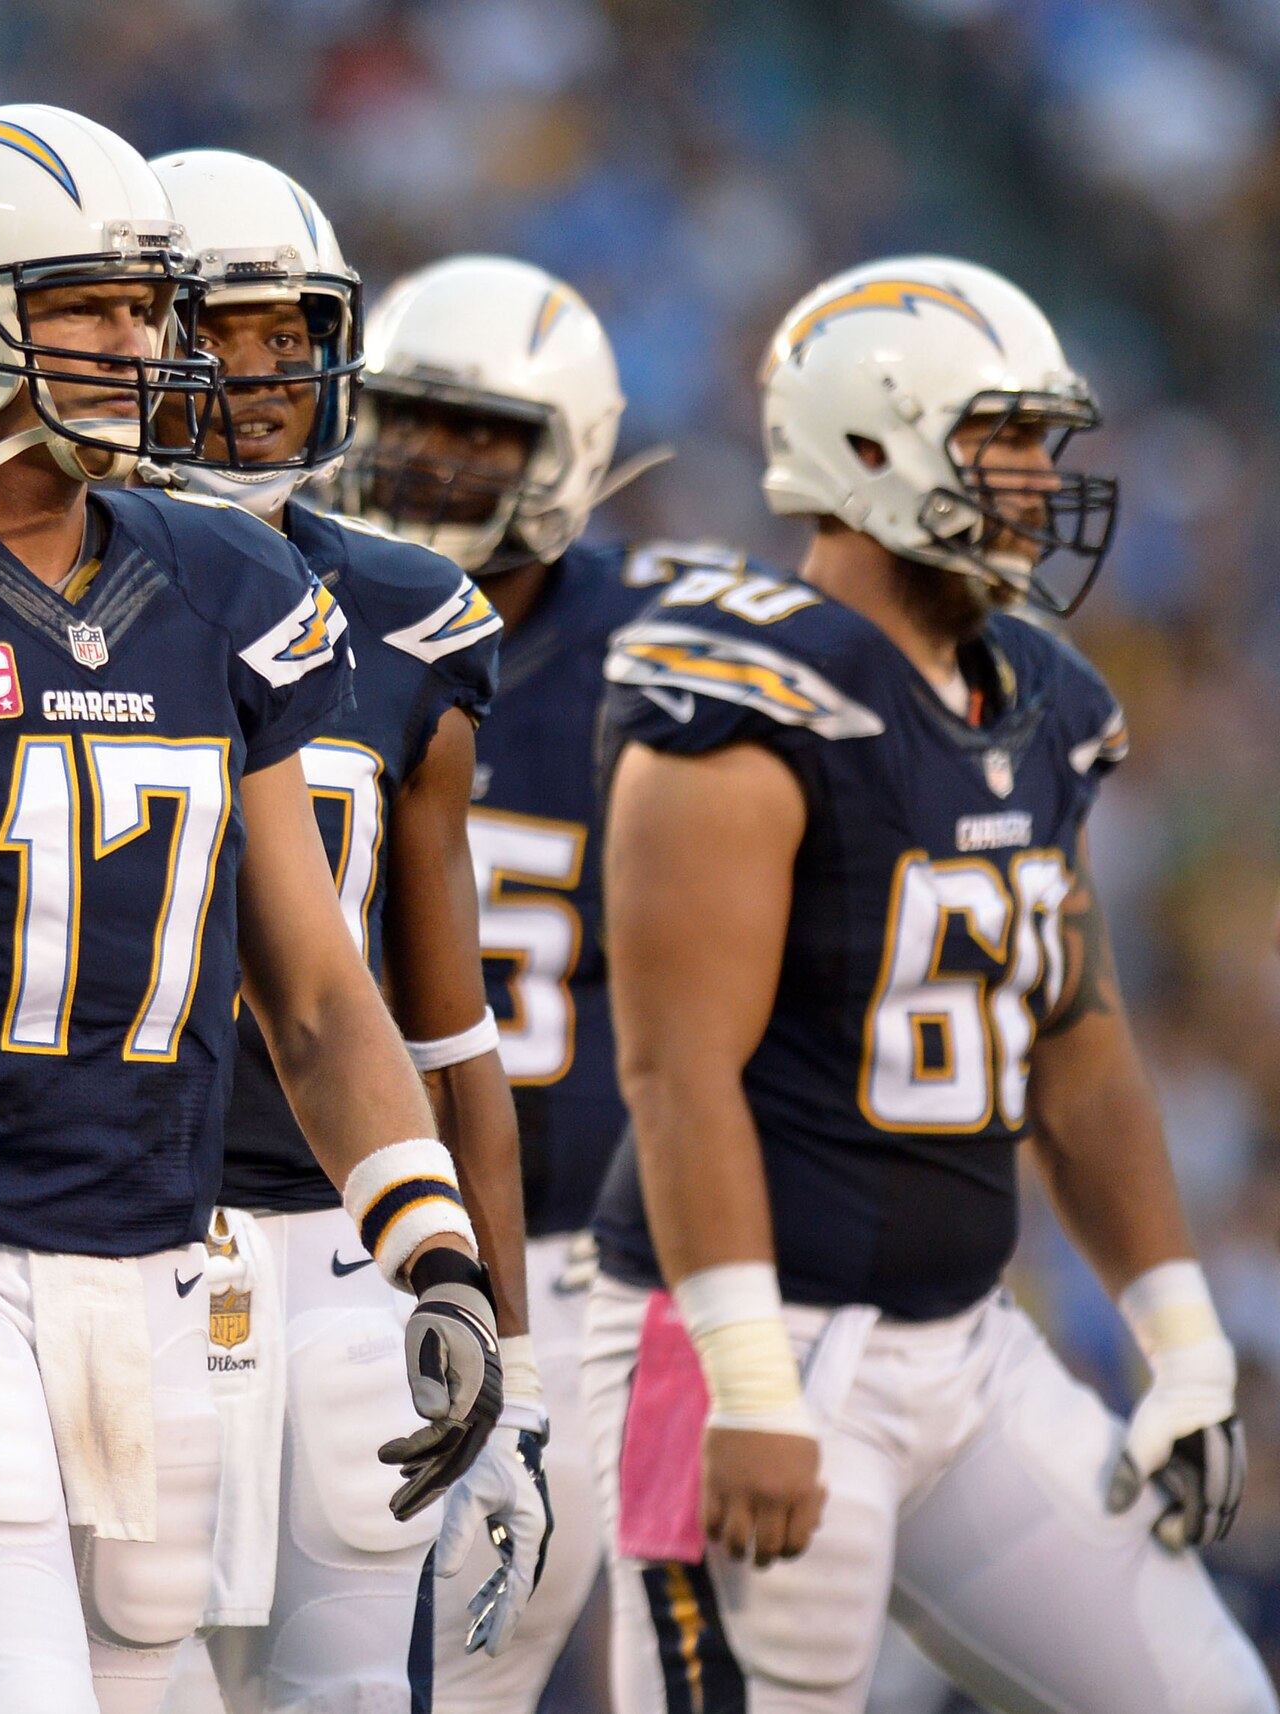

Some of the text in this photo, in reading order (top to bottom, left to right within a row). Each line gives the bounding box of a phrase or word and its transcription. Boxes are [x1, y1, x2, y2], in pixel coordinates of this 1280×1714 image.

[77, 643, 103, 661] NFL
[42, 691, 156, 722] CHARGERS
[212, 1313, 247, 1343] NFL
